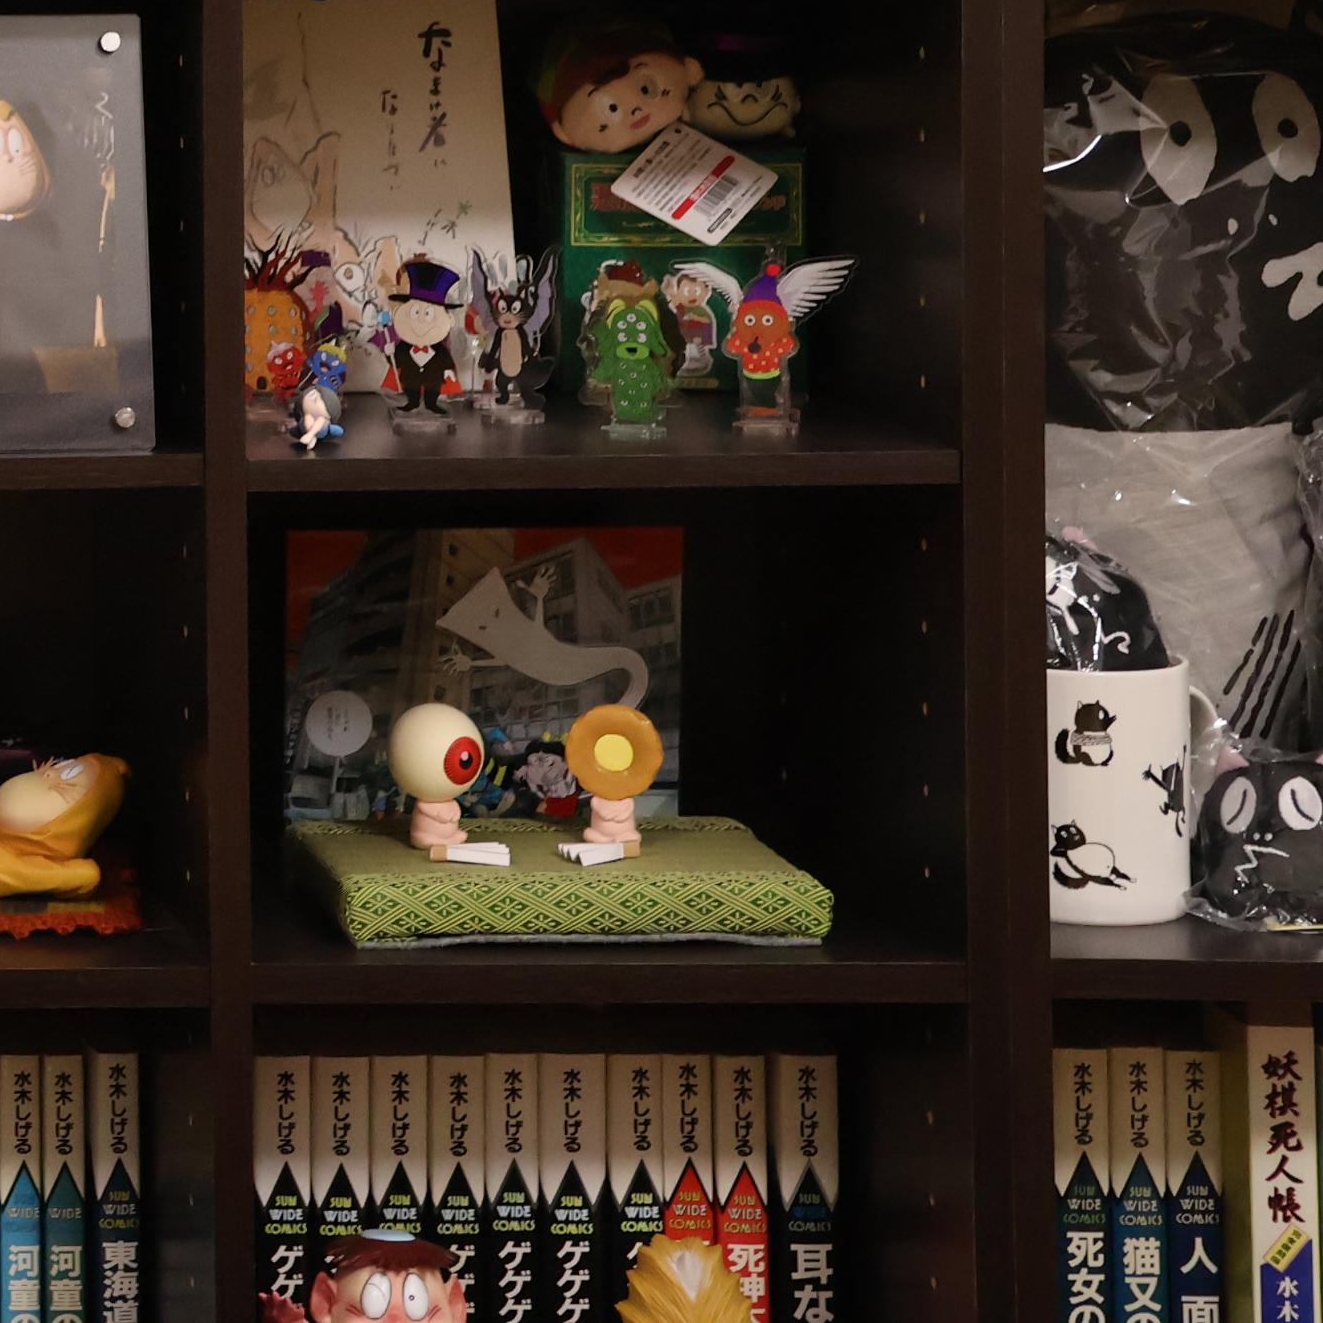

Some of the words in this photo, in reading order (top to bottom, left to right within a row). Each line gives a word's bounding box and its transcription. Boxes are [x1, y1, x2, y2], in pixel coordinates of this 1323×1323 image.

[797, 1066, 819, 1157] 水木しげる
[1130, 1061, 1149, 1148] 水木しげる
[497, 1205, 530, 1218] WIDE
